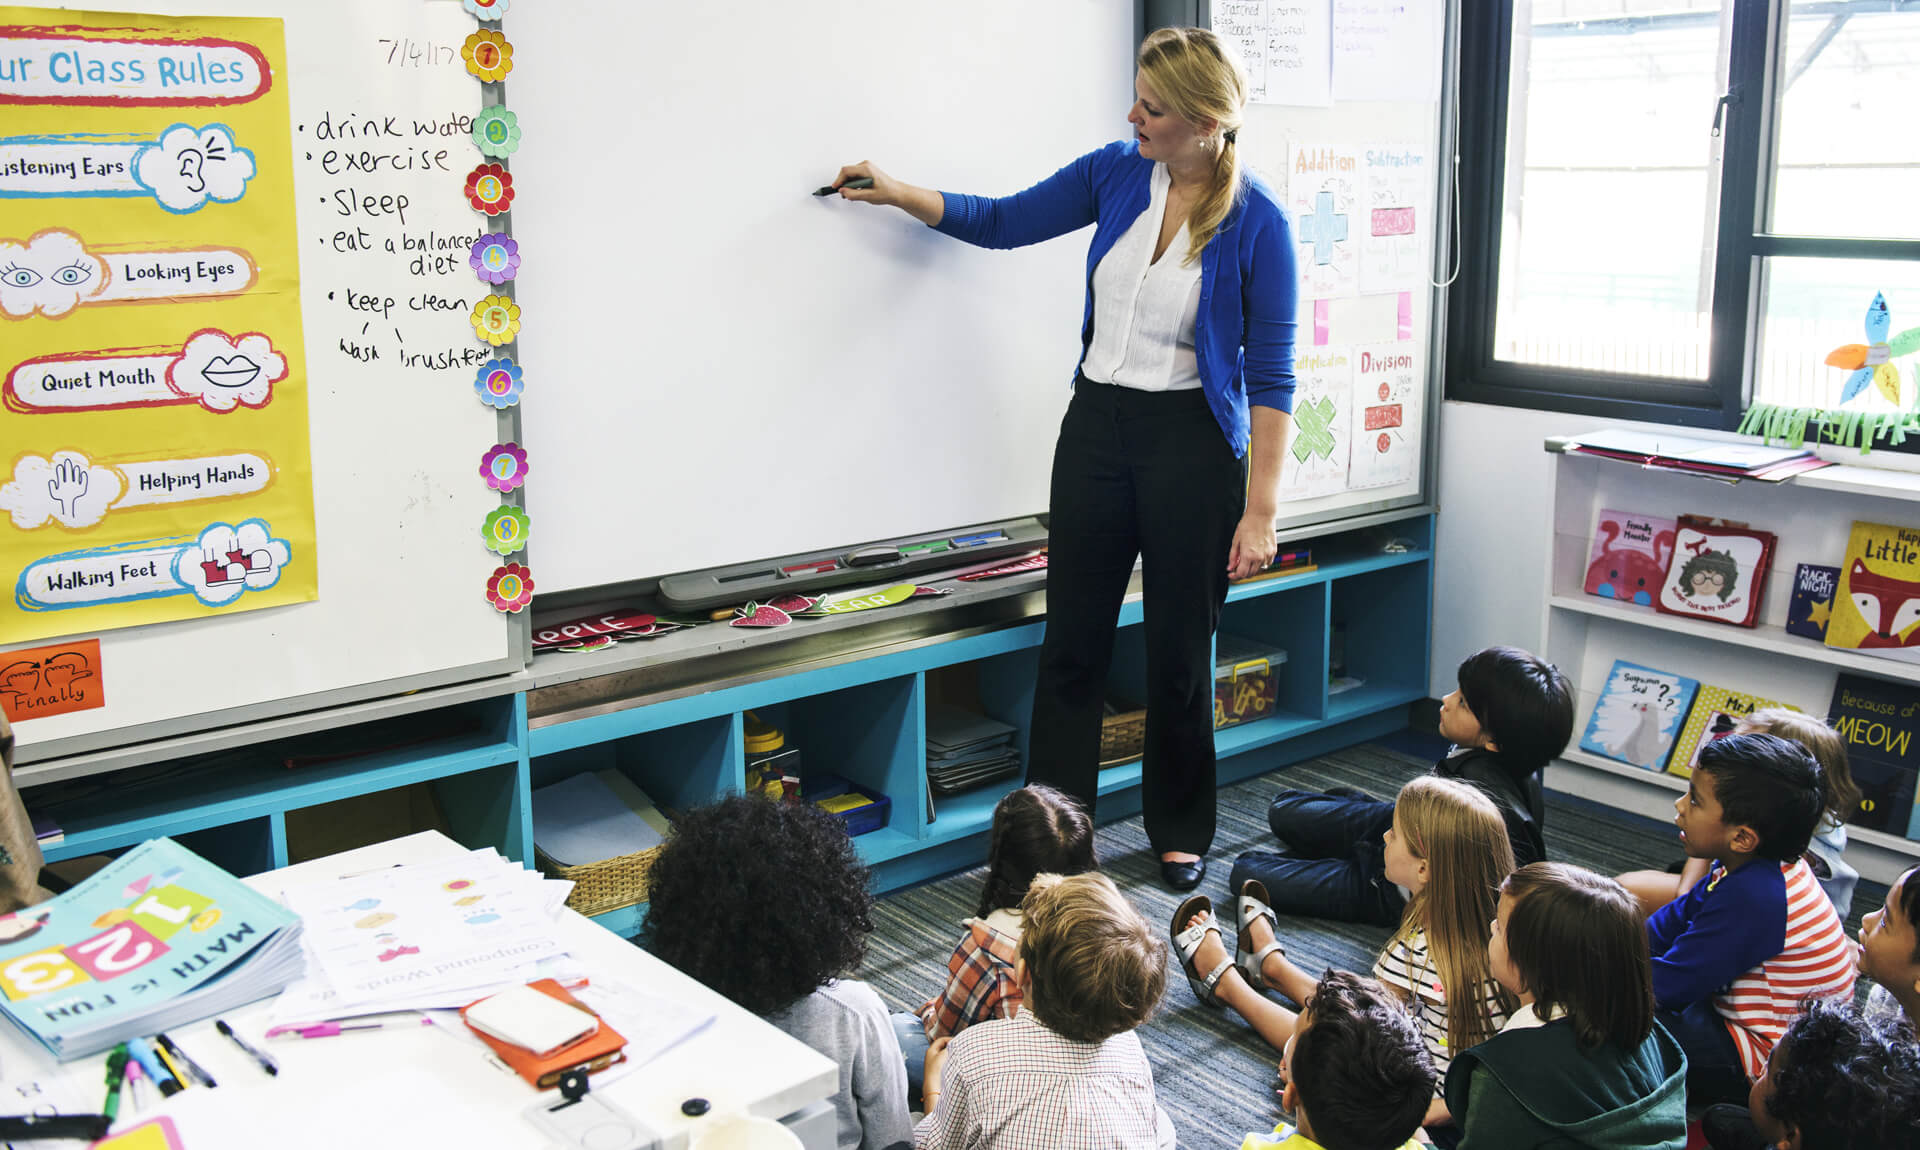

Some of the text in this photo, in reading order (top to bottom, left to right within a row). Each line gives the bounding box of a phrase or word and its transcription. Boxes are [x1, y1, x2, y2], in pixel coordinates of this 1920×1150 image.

[482, 47, 493, 64] 1
[49, 50, 145, 85] Class
[158, 52, 245, 87] Rules
[316, 111, 475, 140] drink wate
[489, 121, 505, 142] 2
[0, 156, 125, 180] istening Ears
[322, 148, 450, 175] exercise
[1295, 148, 1356, 174] Addition
[483, 178, 496, 199] 3
[332, 227, 372, 252] eat
[384, 237, 396, 254] a
[410, 253, 459, 276] diet
[489, 247, 502, 267] 4
[124, 261, 236, 282] Looking Eyes
[347, 288, 469, 320] keep clean
[489, 310, 503, 329] 5
[1360, 351, 1413, 374] Division
[41, 367, 156, 391] Quiet Mouth
[492, 372, 506, 393] 6
[139, 464, 255, 492] Helping Hands
[497, 457, 512, 477] 7
[500, 519, 513, 540] 8
[1898, 529, 1920, 547] Hap
[1865, 539, 1917, 565] Little
[47, 561, 157, 591] Walking Feet
[503, 576, 517, 598] 9
[1799, 568, 1832, 584] MAGIC
[1800, 579, 1835, 594] NIGHT
[532, 616, 632, 645] PPLE
[14, 687, 85, 711] Finally
[1834, 714, 1912, 757] MEOW
[132, 895, 193, 925] 1
[77, 926, 154, 973] 2
[171, 921, 256, 980] MATH
[434, 940, 556, 973] Compound
[3, 951, 75, 993] 3
[44, 993, 118, 1022] FUN
